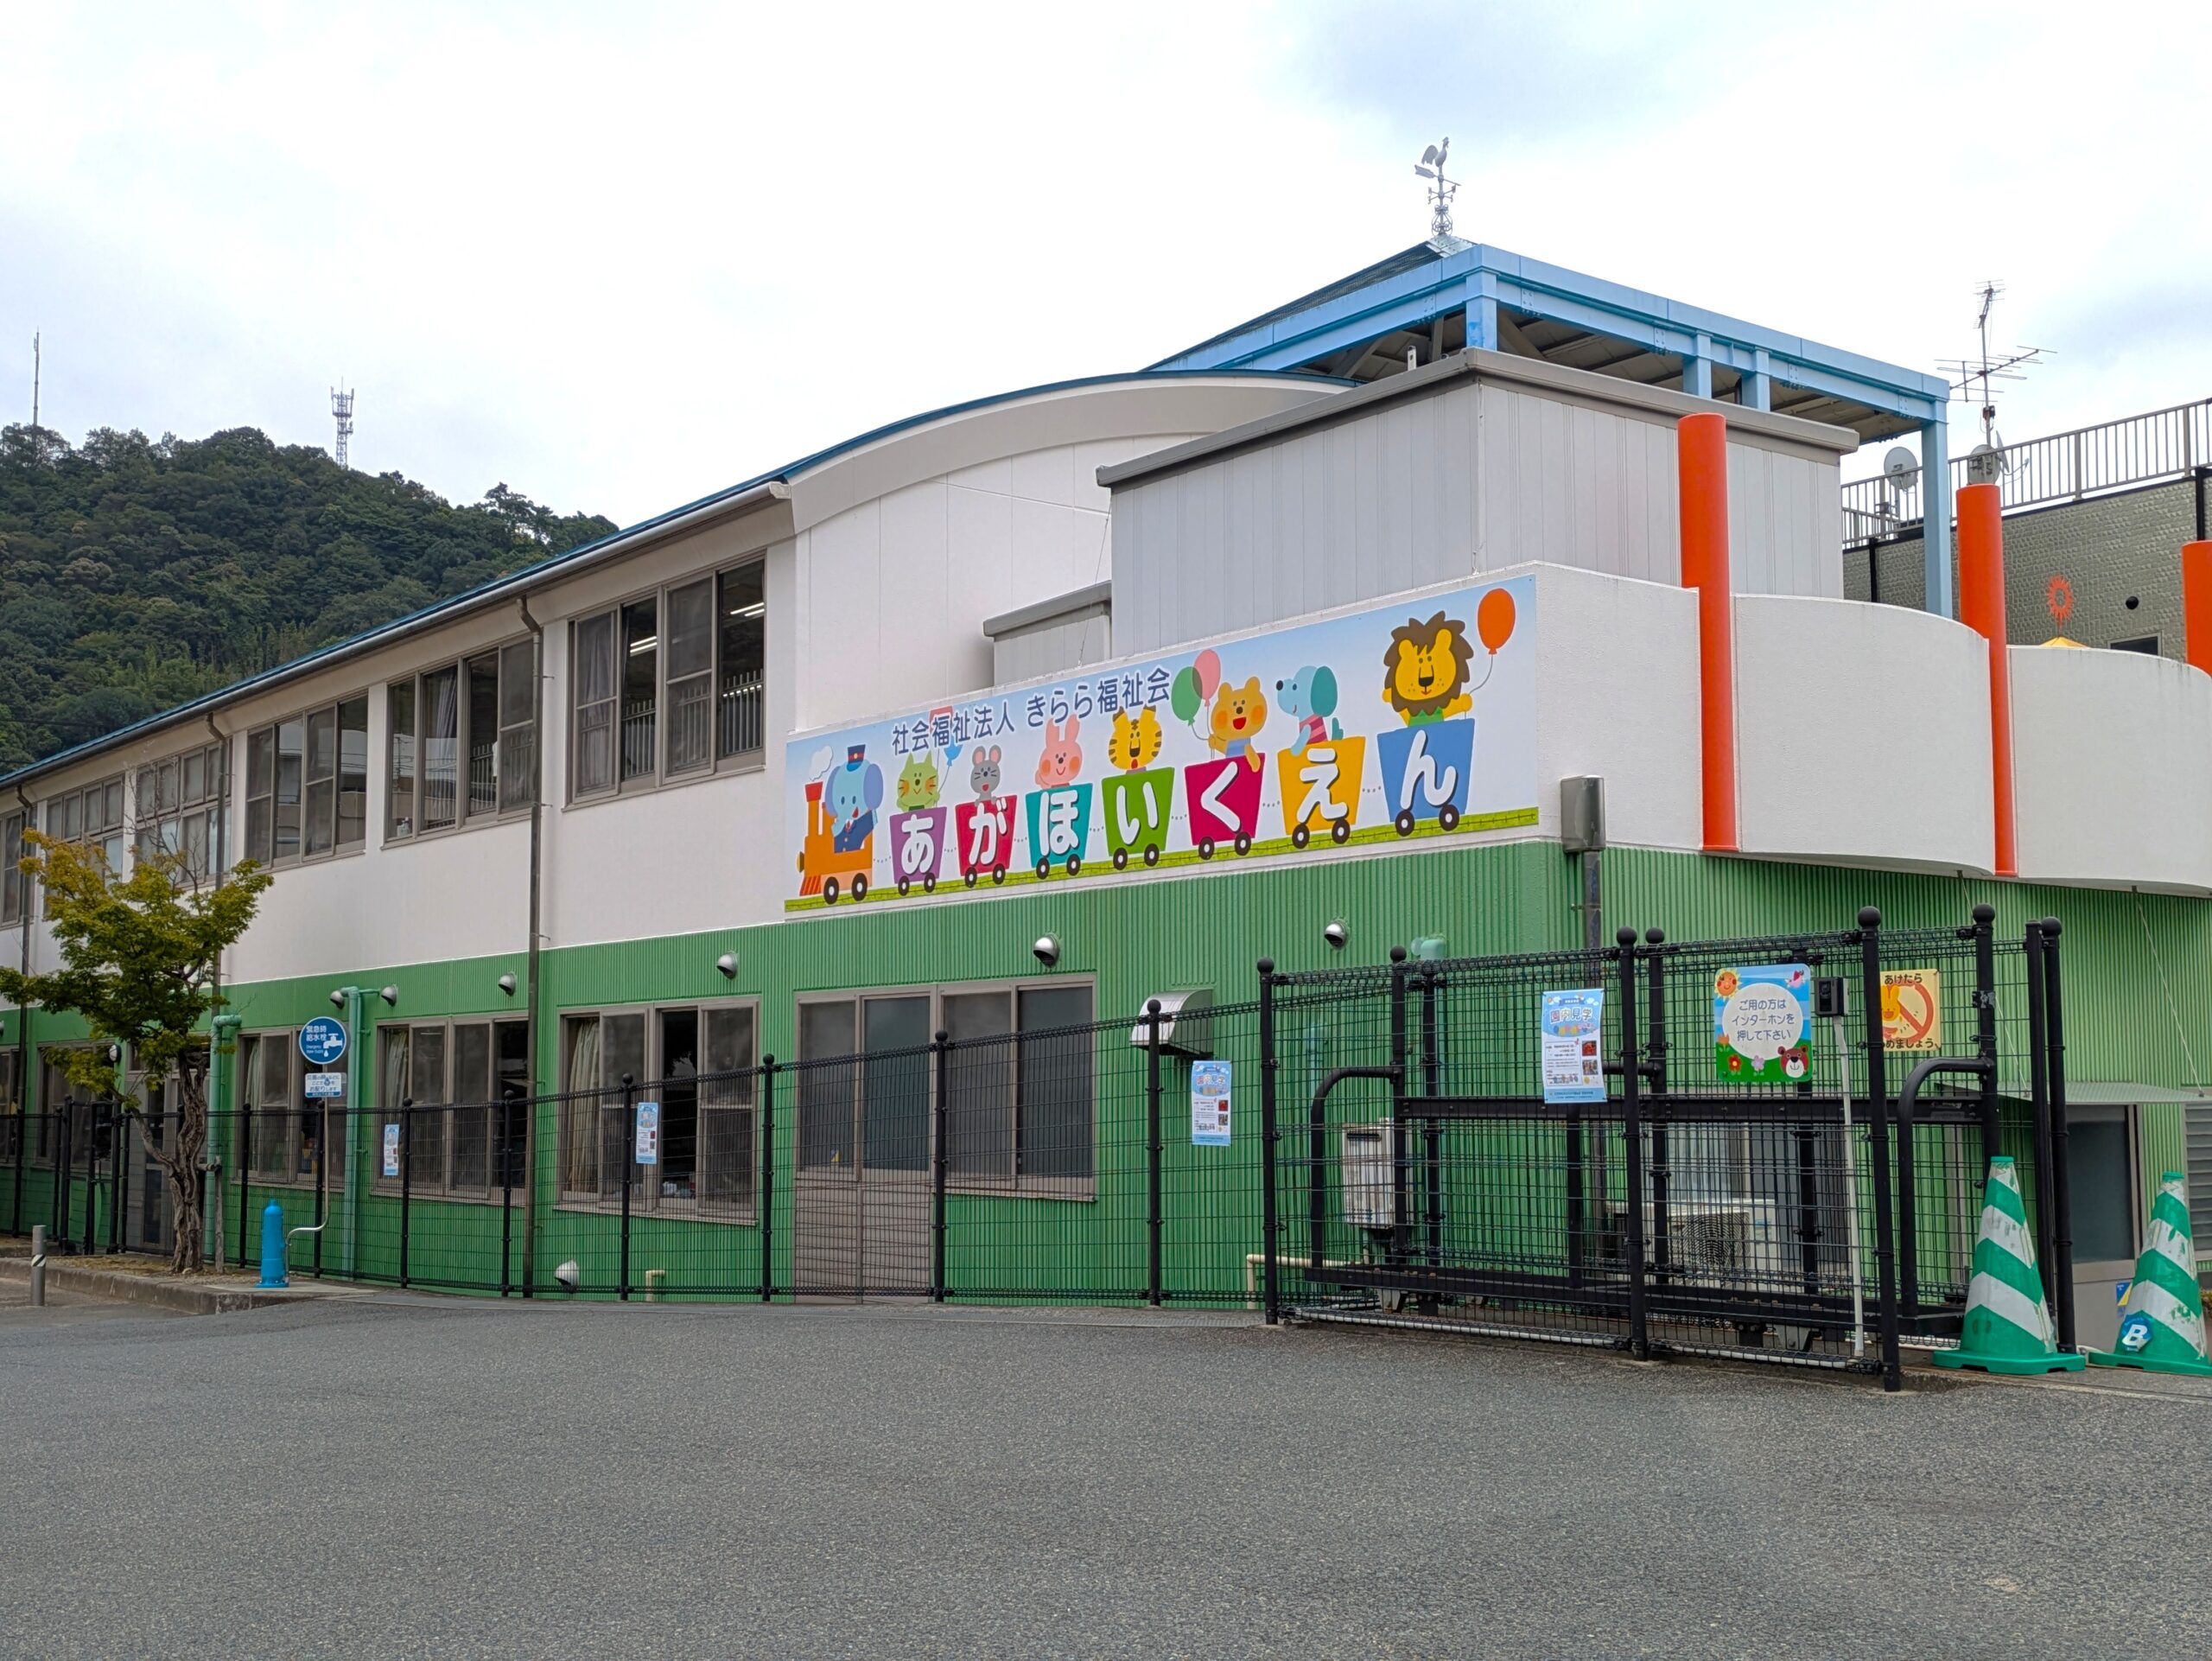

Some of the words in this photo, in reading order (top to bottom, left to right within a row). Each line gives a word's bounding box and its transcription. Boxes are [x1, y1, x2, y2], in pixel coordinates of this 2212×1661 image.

[892, 702, 1015, 756] 社会福祉法人
[1027, 667, 1171, 728] きらら福祉会
[900, 729, 1458, 876] あがほいくえん
[1885, 973, 1923, 984] あけたら
[1738, 999, 1787, 1011] ご用の方は
[1732, 1013, 1796, 1027] インターホンを
[1737, 1029, 1791, 1041] 押して下さい
[1883, 1038, 1934, 1049] めましょう
